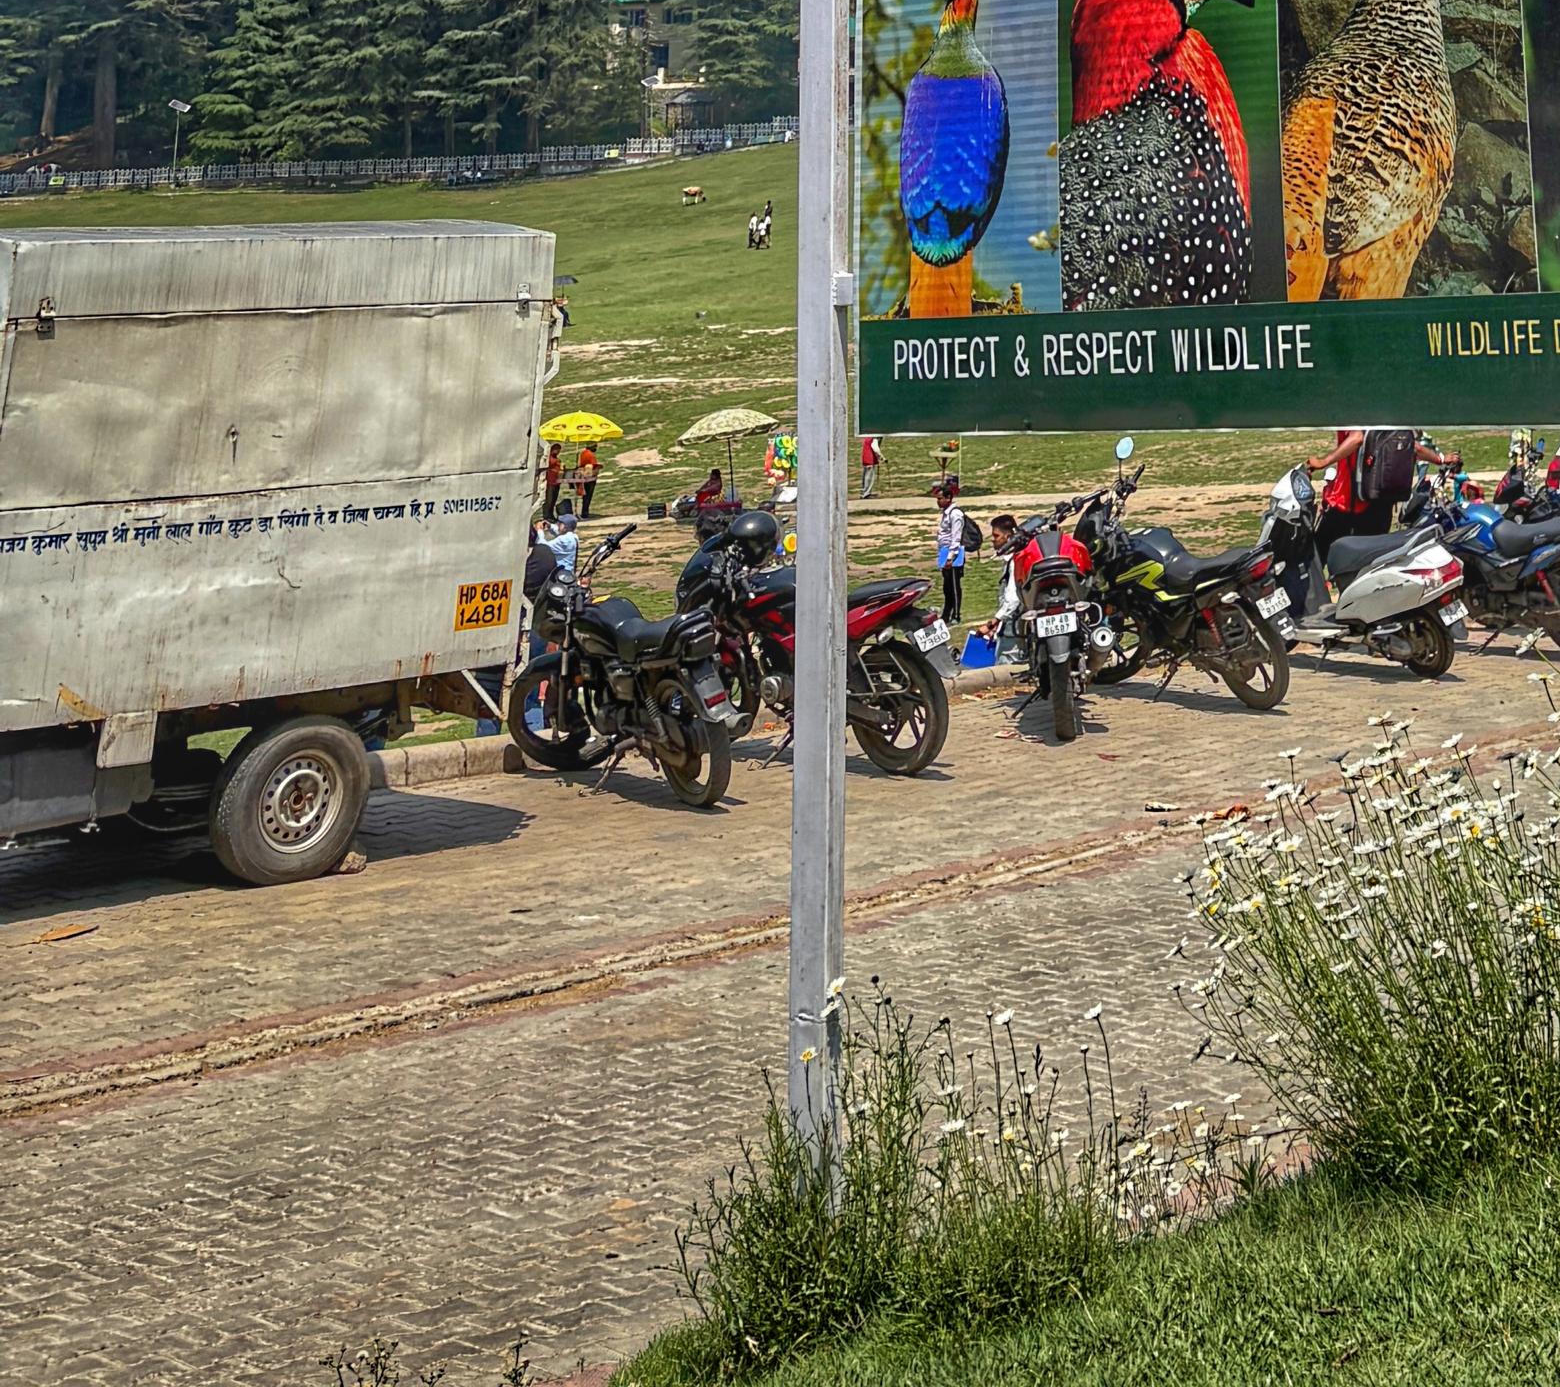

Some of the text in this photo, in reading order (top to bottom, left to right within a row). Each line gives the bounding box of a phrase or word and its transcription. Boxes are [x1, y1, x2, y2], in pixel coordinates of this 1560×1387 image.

[893, 323, 1315, 381] PROTECT & RESPECT WILDLIFE
[1426, 318, 1544, 357] WILDLIFE
[31, 531, 73, 555] कुमार
[112, 522, 131, 544] श्री
[165, 522, 195, 546] लाल
[460, 581, 508, 605] HP 68A
[460, 603, 502, 627] 1481
